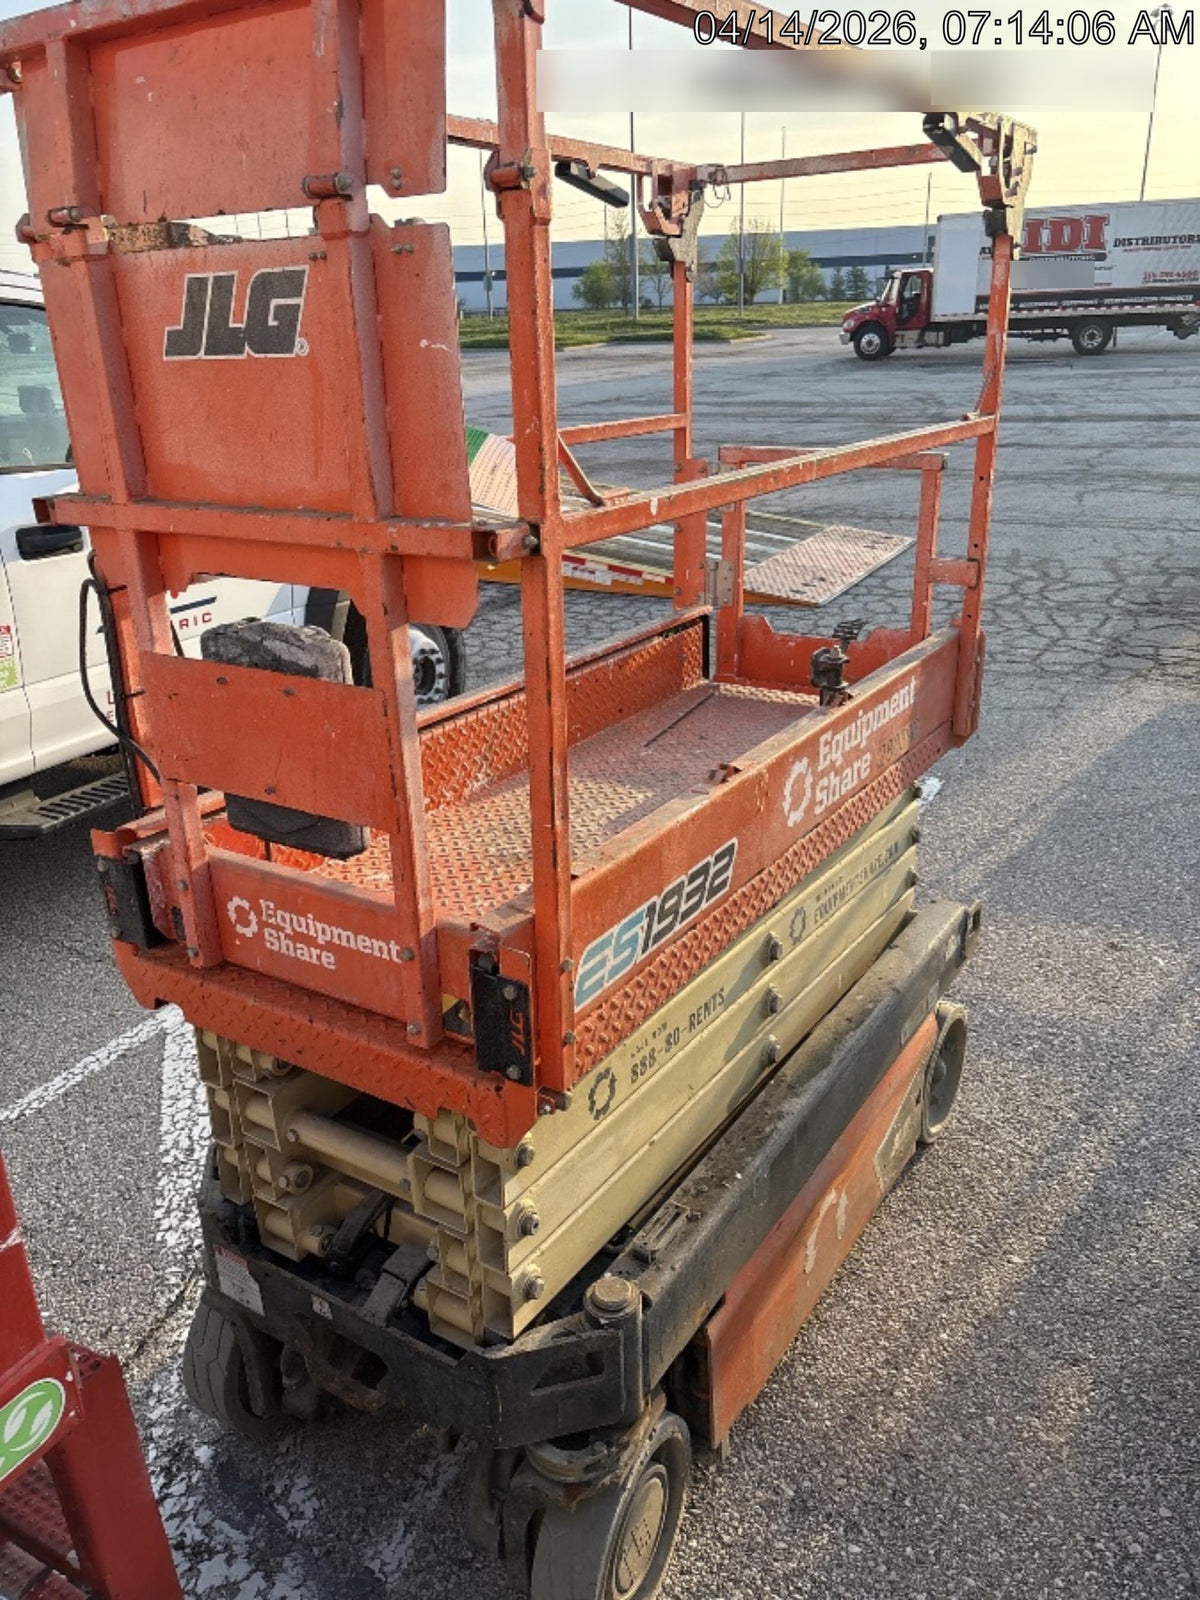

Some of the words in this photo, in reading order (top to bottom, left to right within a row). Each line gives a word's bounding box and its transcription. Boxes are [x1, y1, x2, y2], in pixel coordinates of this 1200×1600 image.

[163, 265, 309, 360] JLG
[816, 675, 916, 772] Equipment
[813, 752, 872, 816] Share
[259, 899, 402, 964] Equipment
[263, 927, 337, 970] Share
[574, 837, 739, 1014] ES1932
